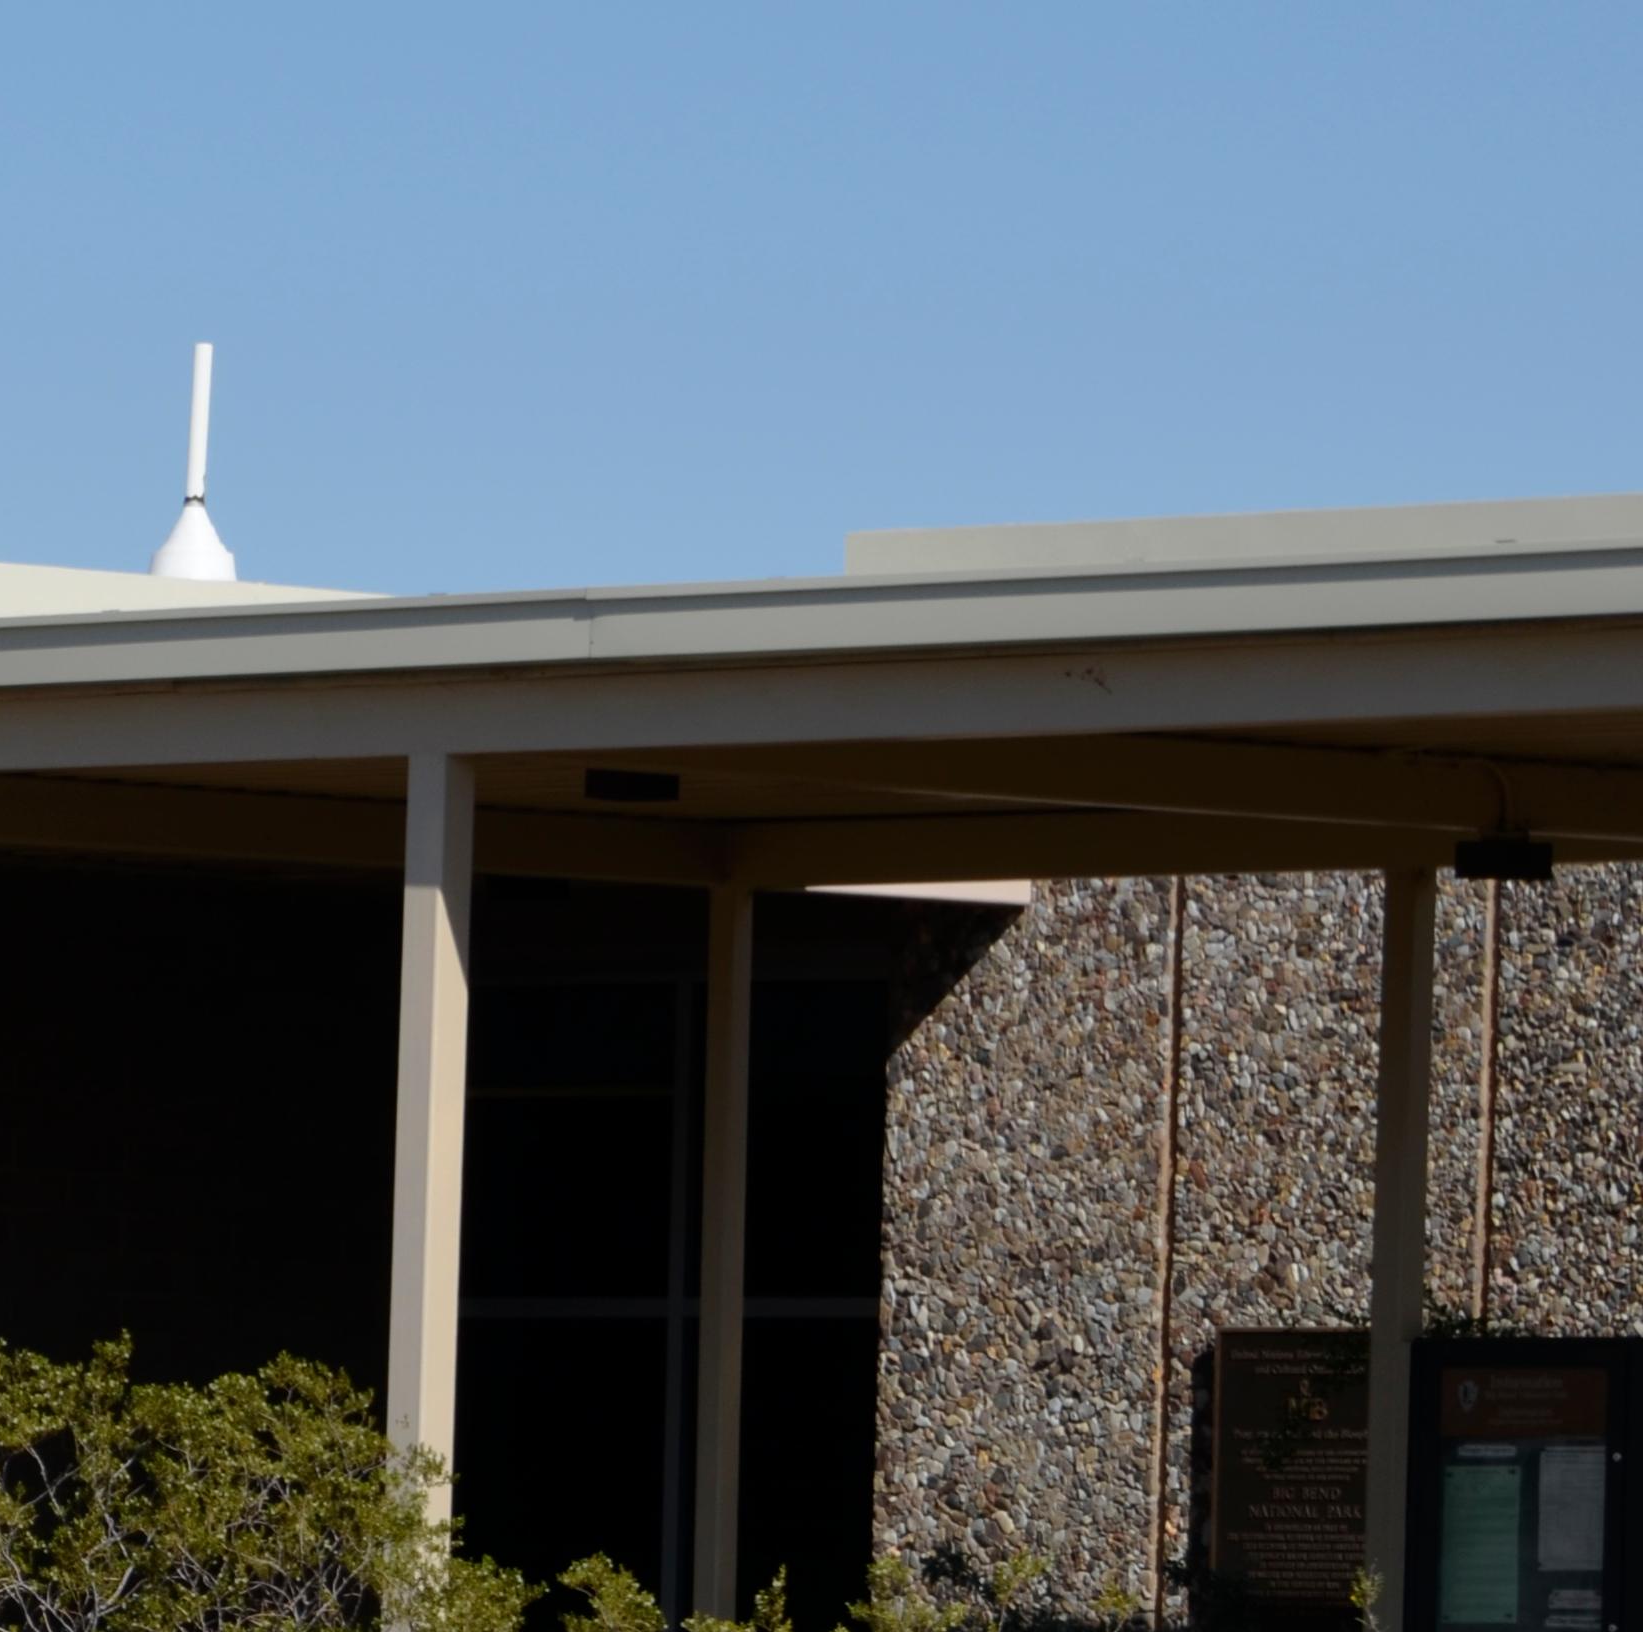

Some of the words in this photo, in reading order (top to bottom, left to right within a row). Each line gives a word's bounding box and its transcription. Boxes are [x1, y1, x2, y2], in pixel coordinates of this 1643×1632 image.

[1272, 1487, 1295, 1500] BIG
[1302, 1487, 1343, 1500] BEND
[1248, 1504, 1319, 1519] NATIONAL
[1327, 1504, 1363, 1519] PARK
